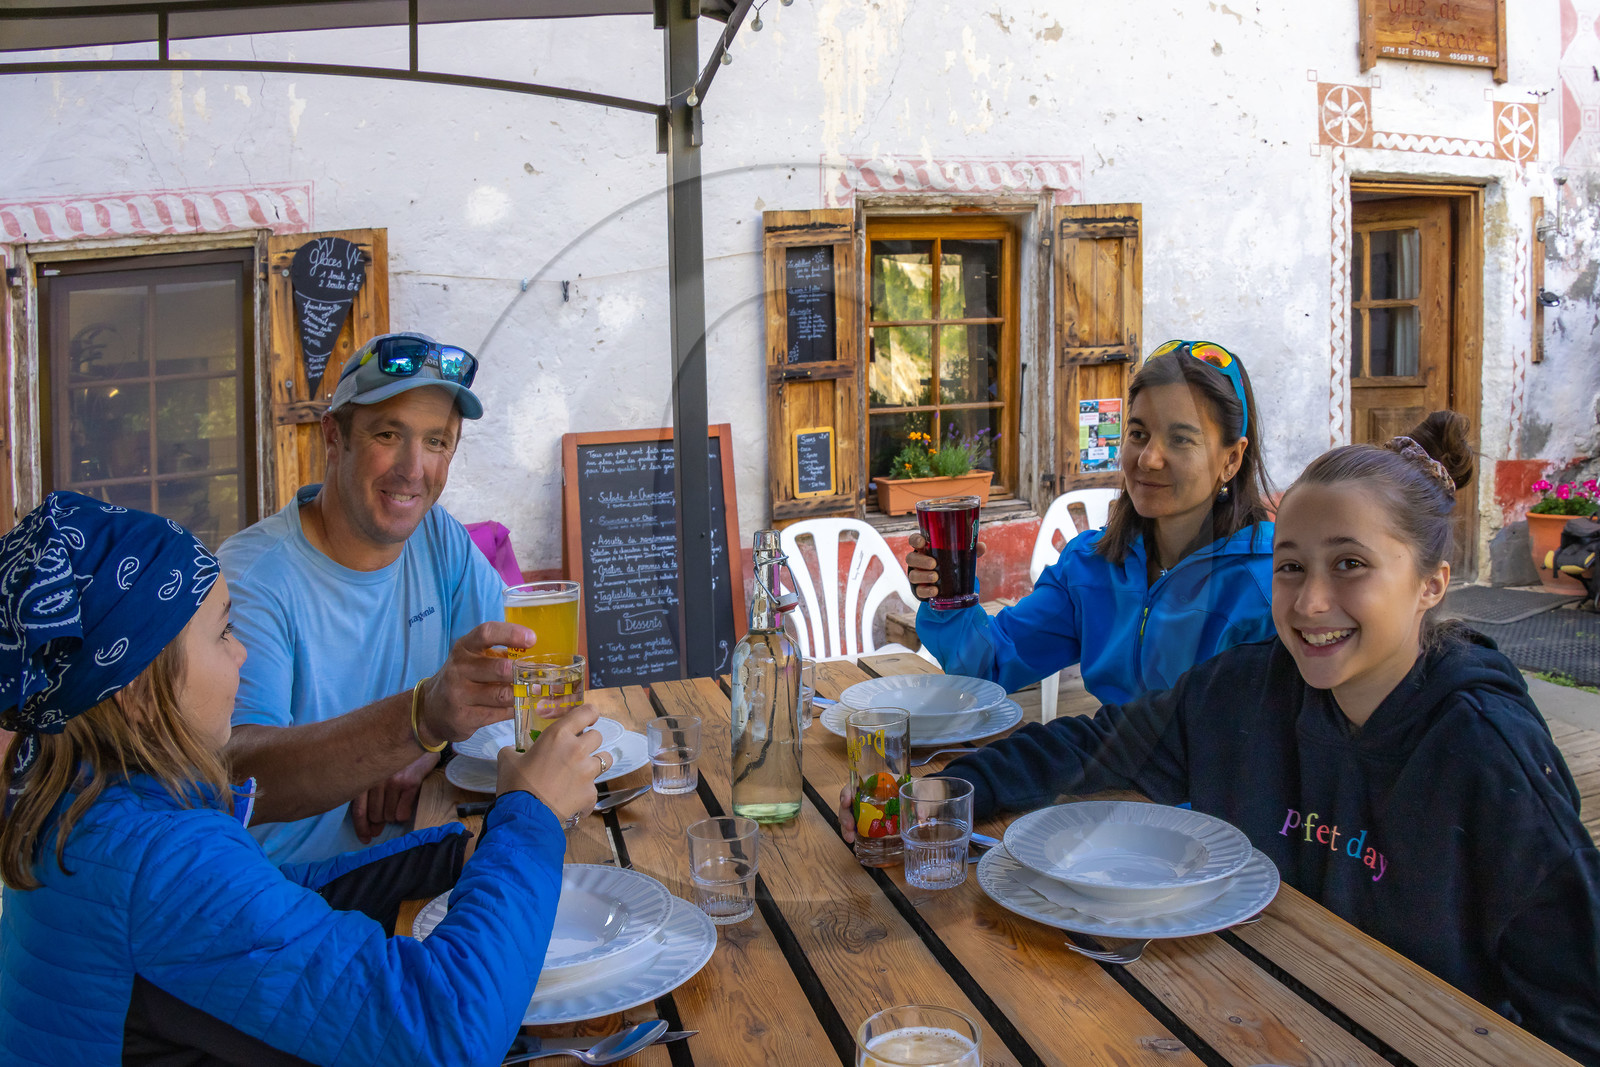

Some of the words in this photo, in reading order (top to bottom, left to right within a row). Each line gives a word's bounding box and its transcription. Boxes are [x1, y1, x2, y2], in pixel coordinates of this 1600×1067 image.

[1398, 47, 1409, 55] 32T
[625, 615, 663, 632] Desserts
[1278, 808, 1341, 851] pfet
[1346, 830, 1389, 882] day
